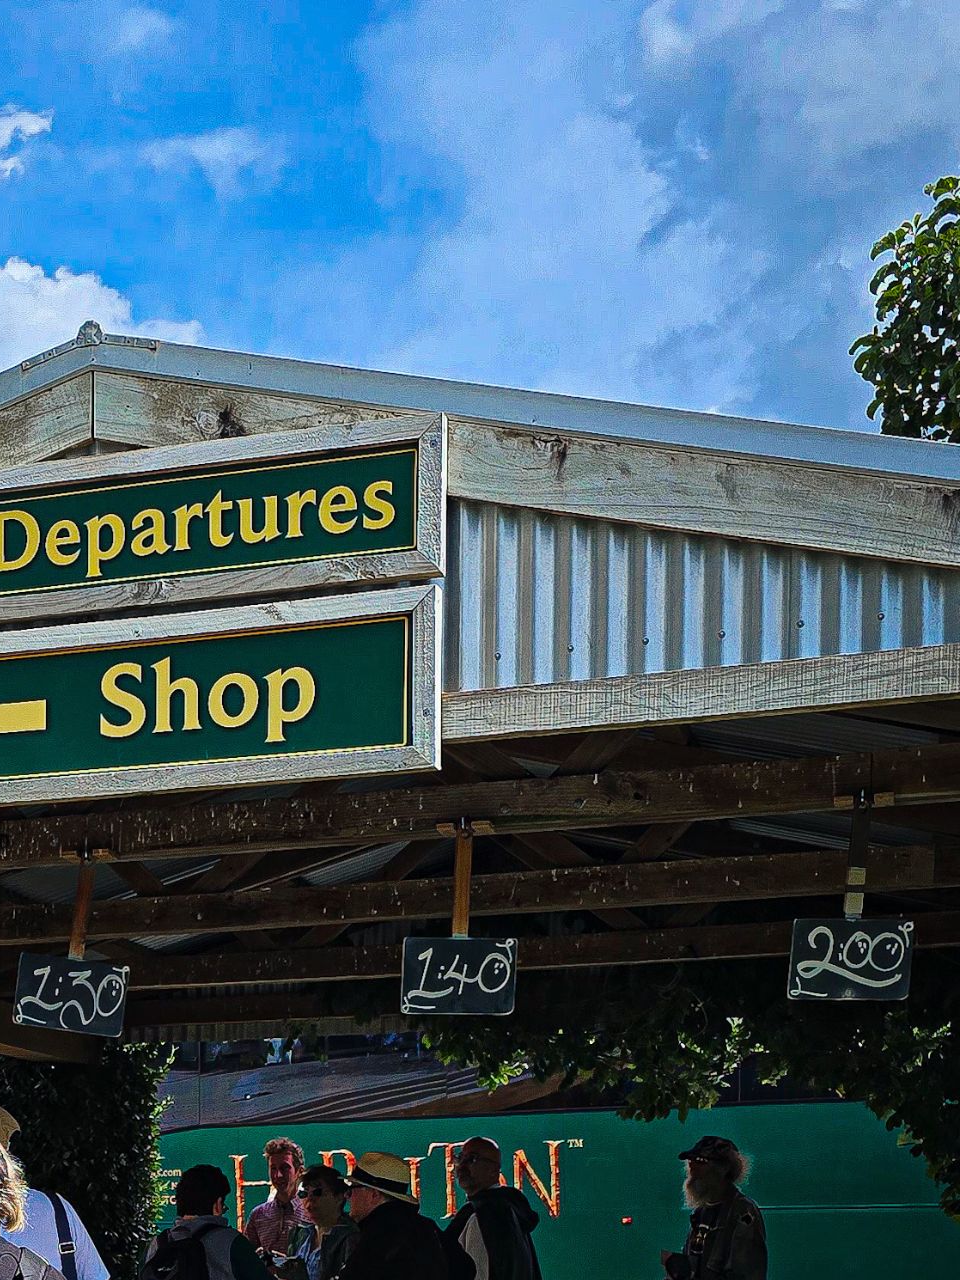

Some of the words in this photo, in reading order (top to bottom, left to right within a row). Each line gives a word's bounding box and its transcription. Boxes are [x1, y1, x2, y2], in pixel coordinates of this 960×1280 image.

[99, 656, 317, 744] Shop
[20, 965, 125, 1029] 1:30
[407, 946, 512, 999] 1:40
